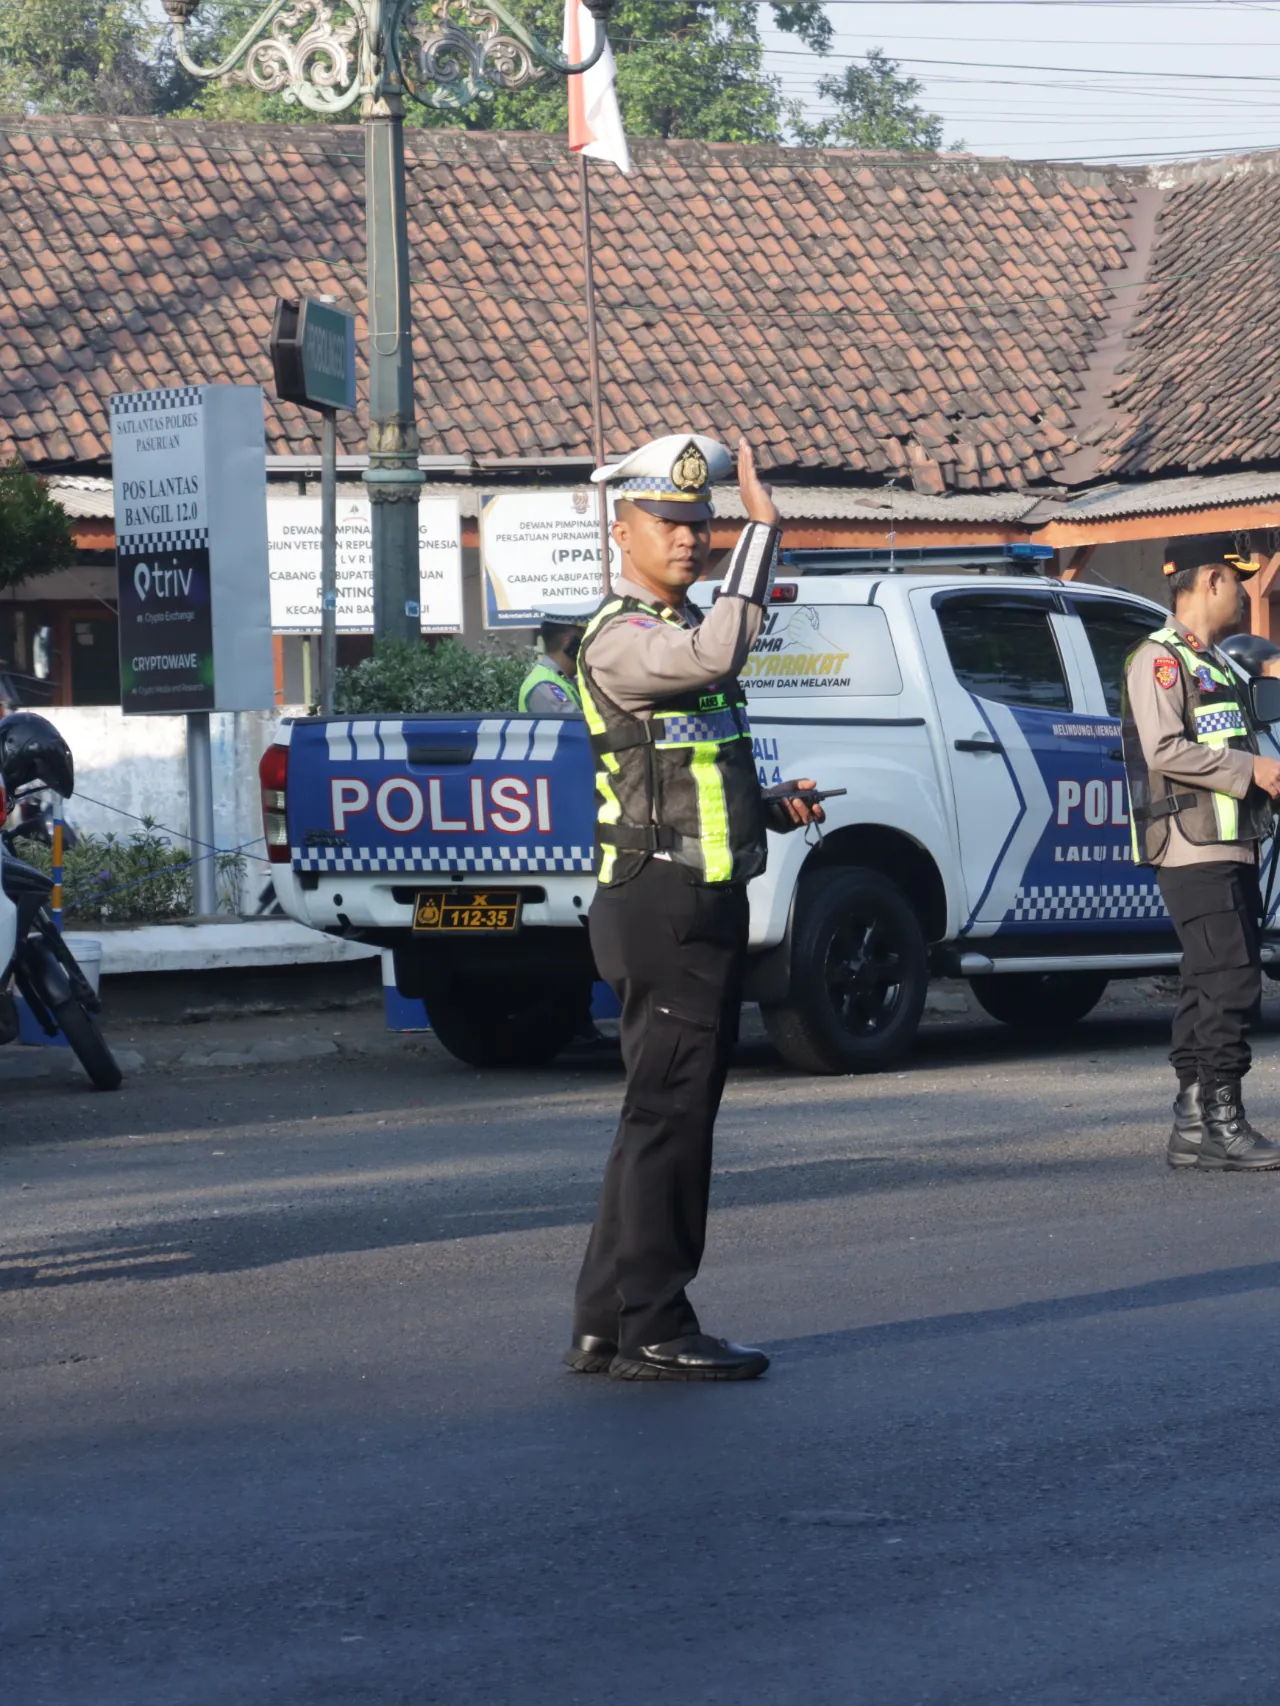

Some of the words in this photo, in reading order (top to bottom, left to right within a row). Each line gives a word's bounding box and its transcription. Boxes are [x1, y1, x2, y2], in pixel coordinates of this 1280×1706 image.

[116, 417, 164, 434] SATLANTAS
[165, 412, 198, 430] POLRES
[136, 435, 180, 452] PASURUAN
[122, 480, 146, 500] POS
[149, 475, 198, 498] LANTAS
[125, 504, 174, 526] BANGIL
[176, 502, 198, 522] 12.0
[283, 526, 322, 535] DEWAN
[520, 522, 553, 530] DEWAN
[269, 571, 316, 580] CABANG
[507, 575, 548, 583] CABANG
[542, 588, 589, 597] RANTING
[132, 653, 197, 671] CRYPTOWAVE
[776, 679, 798, 688] DAN
[800, 678, 850, 687] MELAYANI
[330, 776, 552, 833] POLISI
[1055, 846, 1107, 862] LALU
[472, 895, 488, 906] X
[451, 910, 508, 926] 112-35
